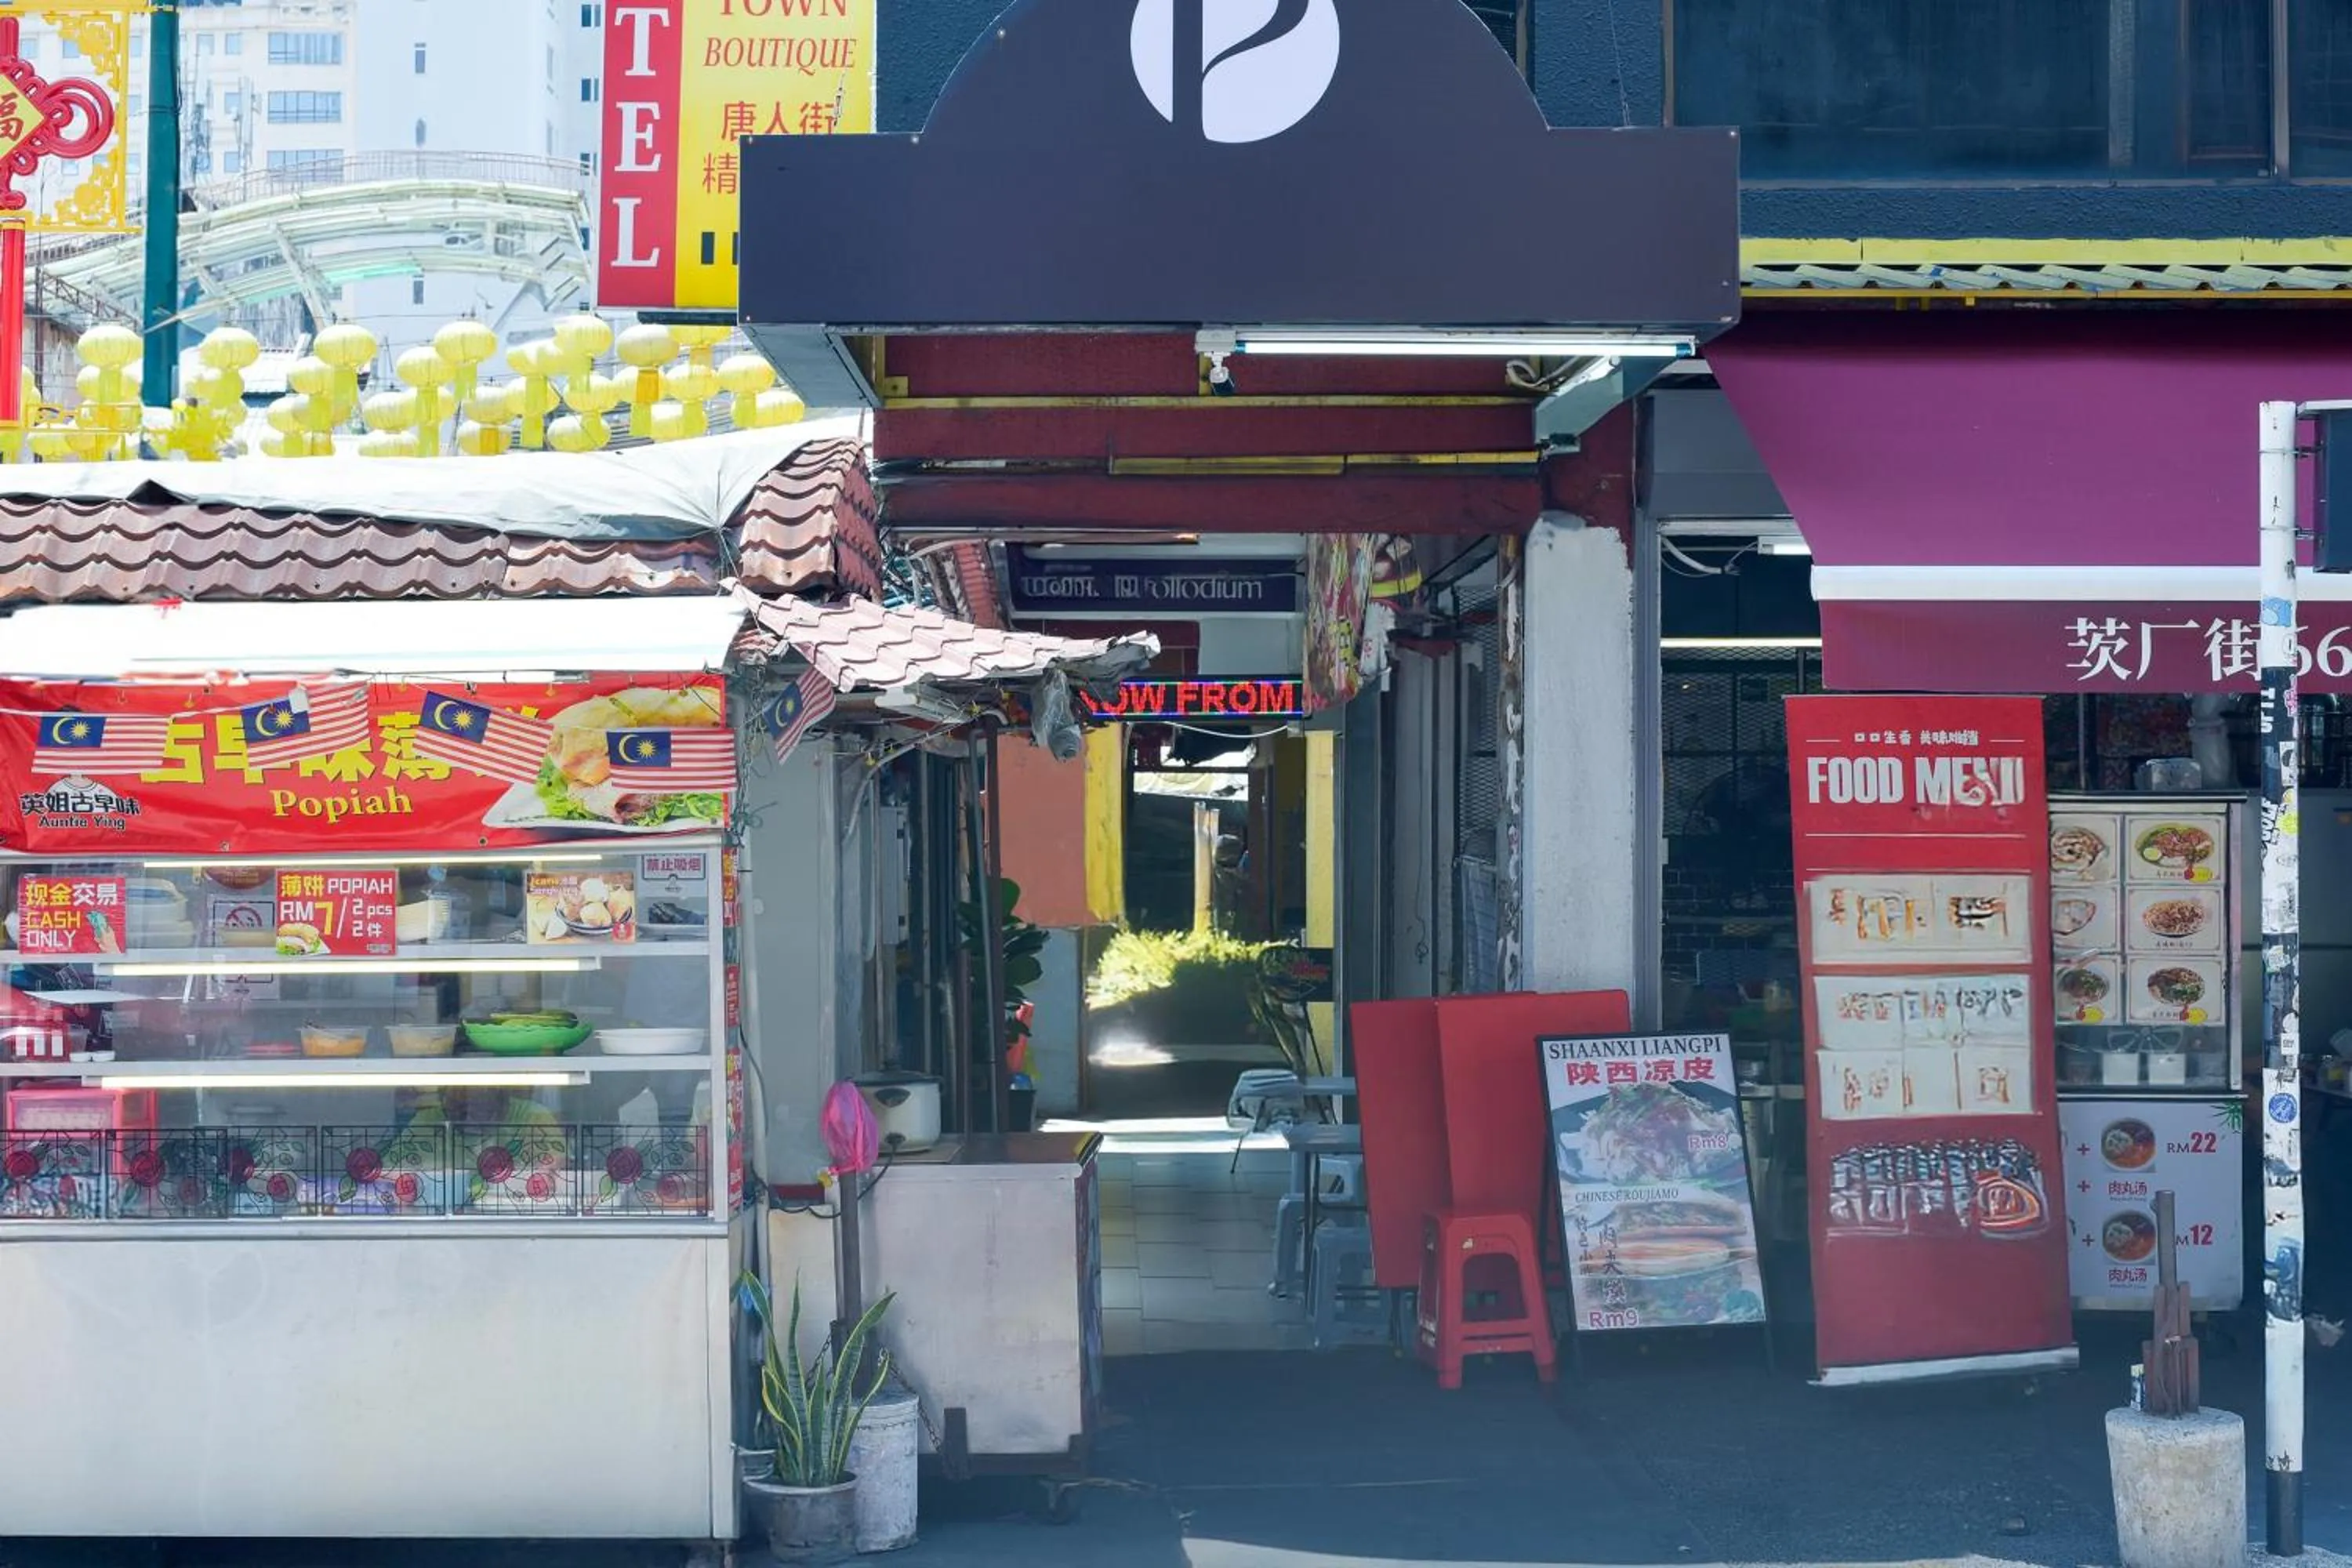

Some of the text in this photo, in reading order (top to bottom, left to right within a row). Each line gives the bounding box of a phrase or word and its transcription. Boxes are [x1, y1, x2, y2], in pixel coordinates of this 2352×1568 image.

[702, 37, 858, 76] BOUTIQUE
[721, 100, 836, 141] 唐人街
[1177, 682, 1294, 714] FROM
[1807, 757, 1904, 804] FOOD
[20, 792, 141, 815] 英姐古早味
[270, 786, 413, 824] Popiah
[39, 815, 125, 830] Auntie Ying
[26, 882, 118, 907] 现金交易
[327, 877, 393, 895] POPIAH
[26, 910, 81, 929] CASH
[27, 929, 77, 948] ONLY
[1548, 1036, 1722, 1059] SHAANXI LIANGPI
[2176, 1224, 2214, 1246] M12
